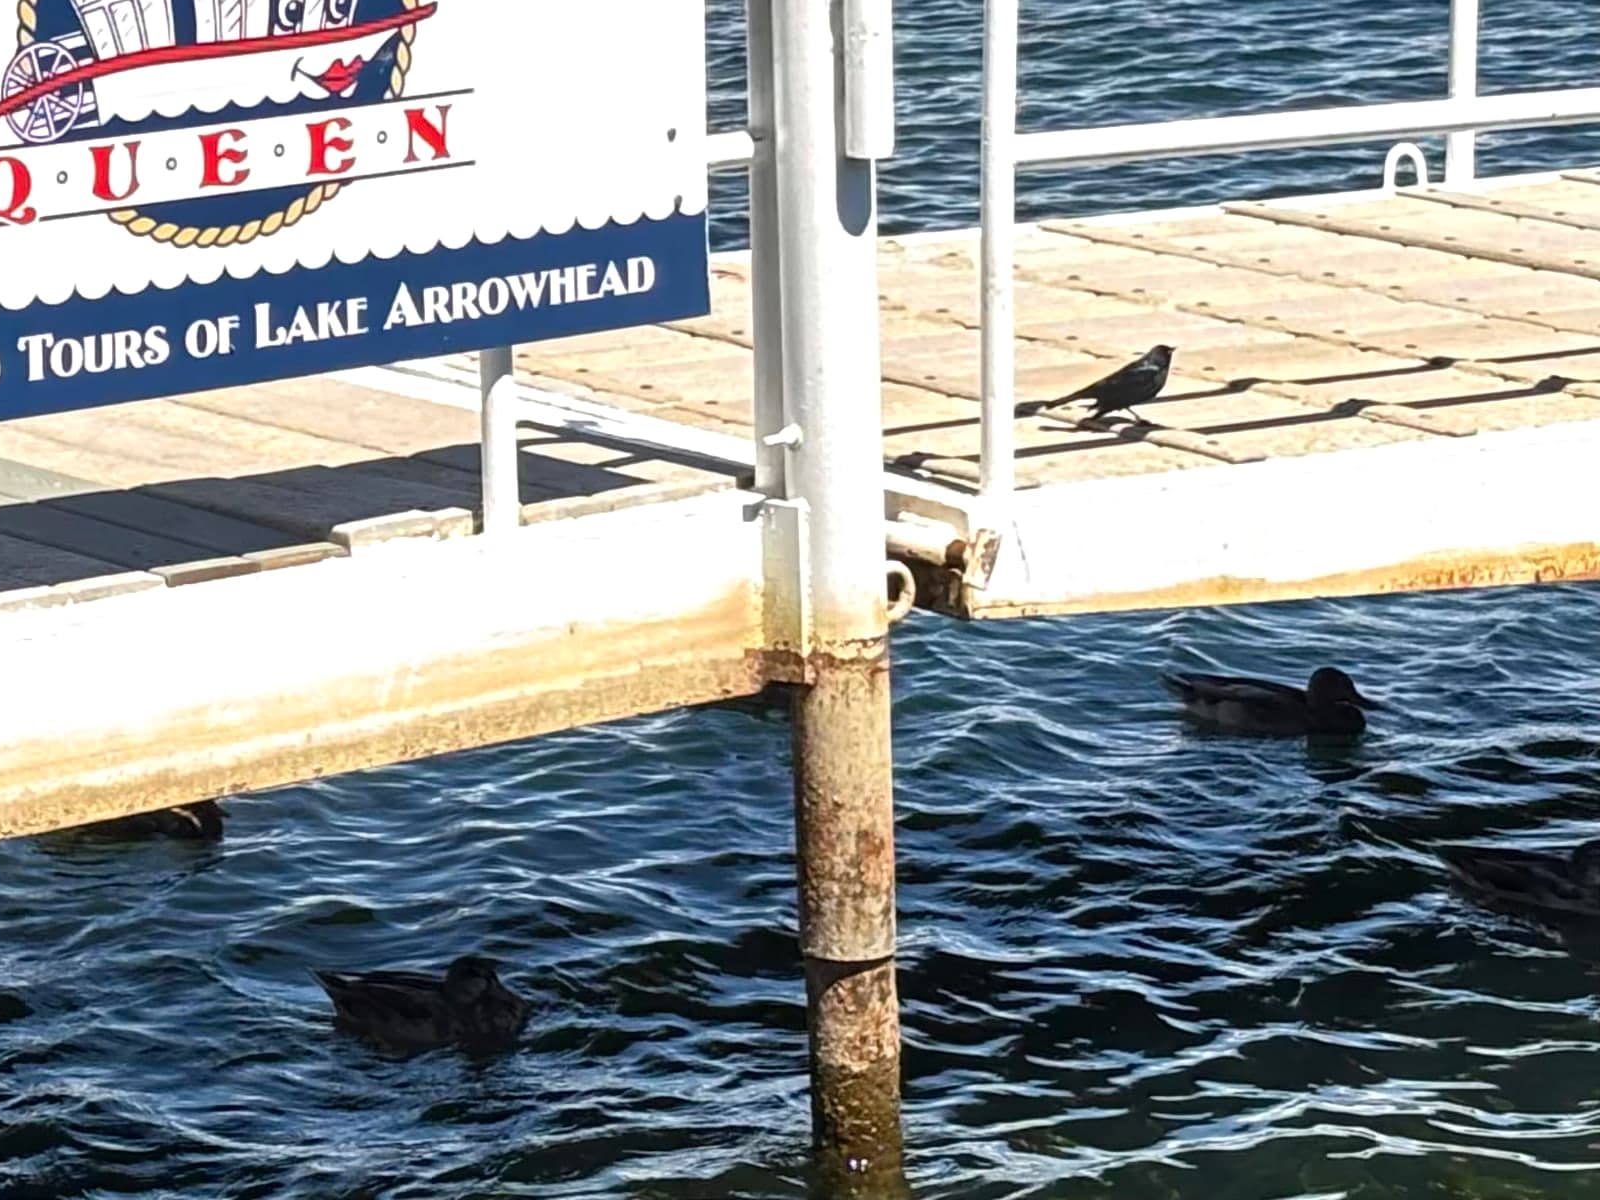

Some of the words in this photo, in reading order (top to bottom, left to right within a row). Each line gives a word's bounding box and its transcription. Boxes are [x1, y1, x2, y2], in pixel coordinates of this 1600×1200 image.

[17, 326, 170, 381] TOURS
[185, 316, 239, 357] OF
[254, 298, 369, 349] LAKE
[383, 257, 656, 330] ARROWHEAD
